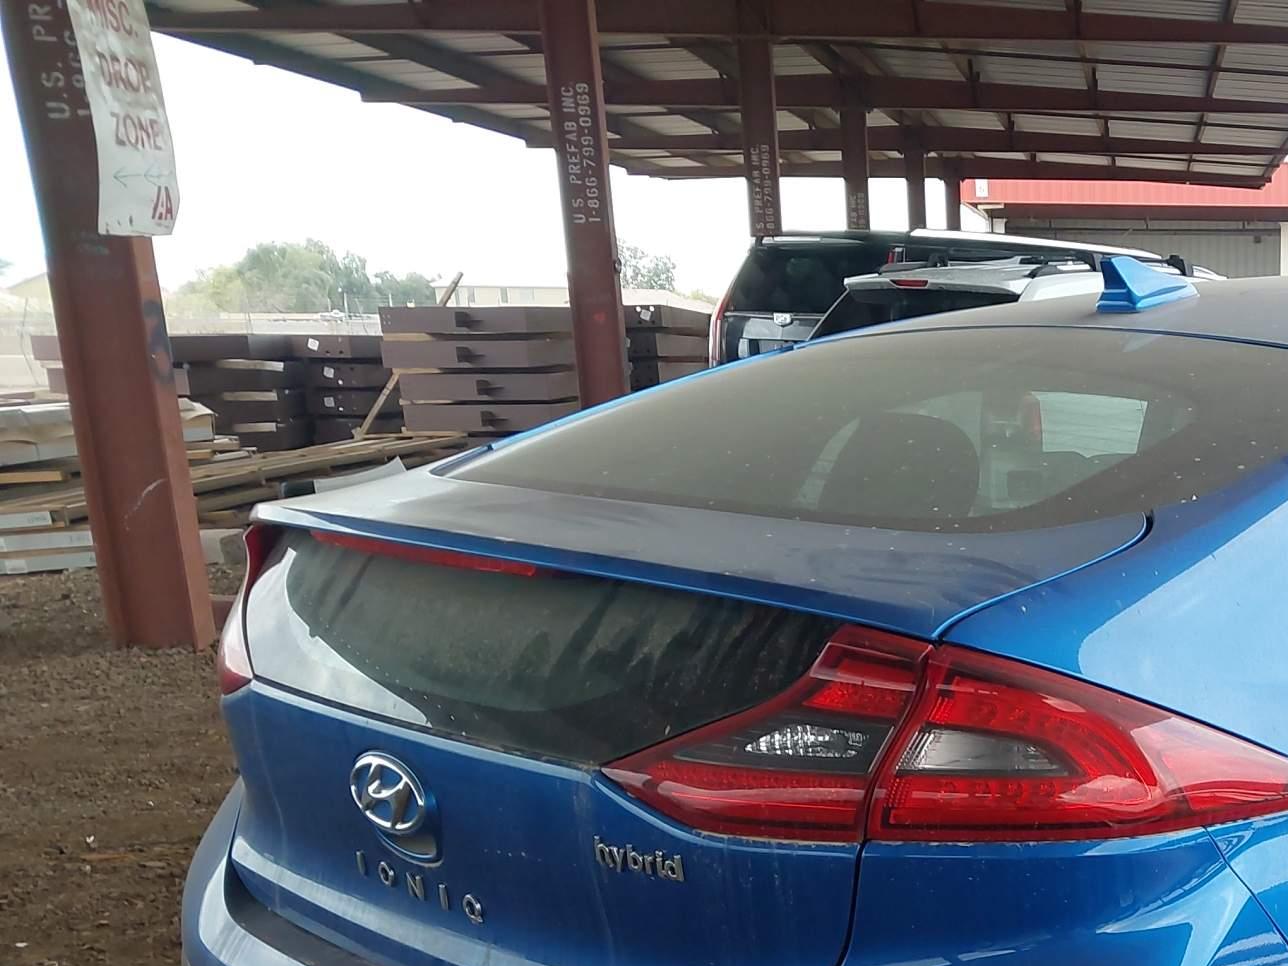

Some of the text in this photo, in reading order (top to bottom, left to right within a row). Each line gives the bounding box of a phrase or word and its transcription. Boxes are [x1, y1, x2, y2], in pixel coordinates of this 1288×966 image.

[111, 111, 163, 152] ZONE
[563, 121, 582, 185] PREFAB
[575, 82, 601, 222] 1-866-799-0969
[356, 849, 484, 924] IONIQ
[593, 834, 685, 882] hybrid
